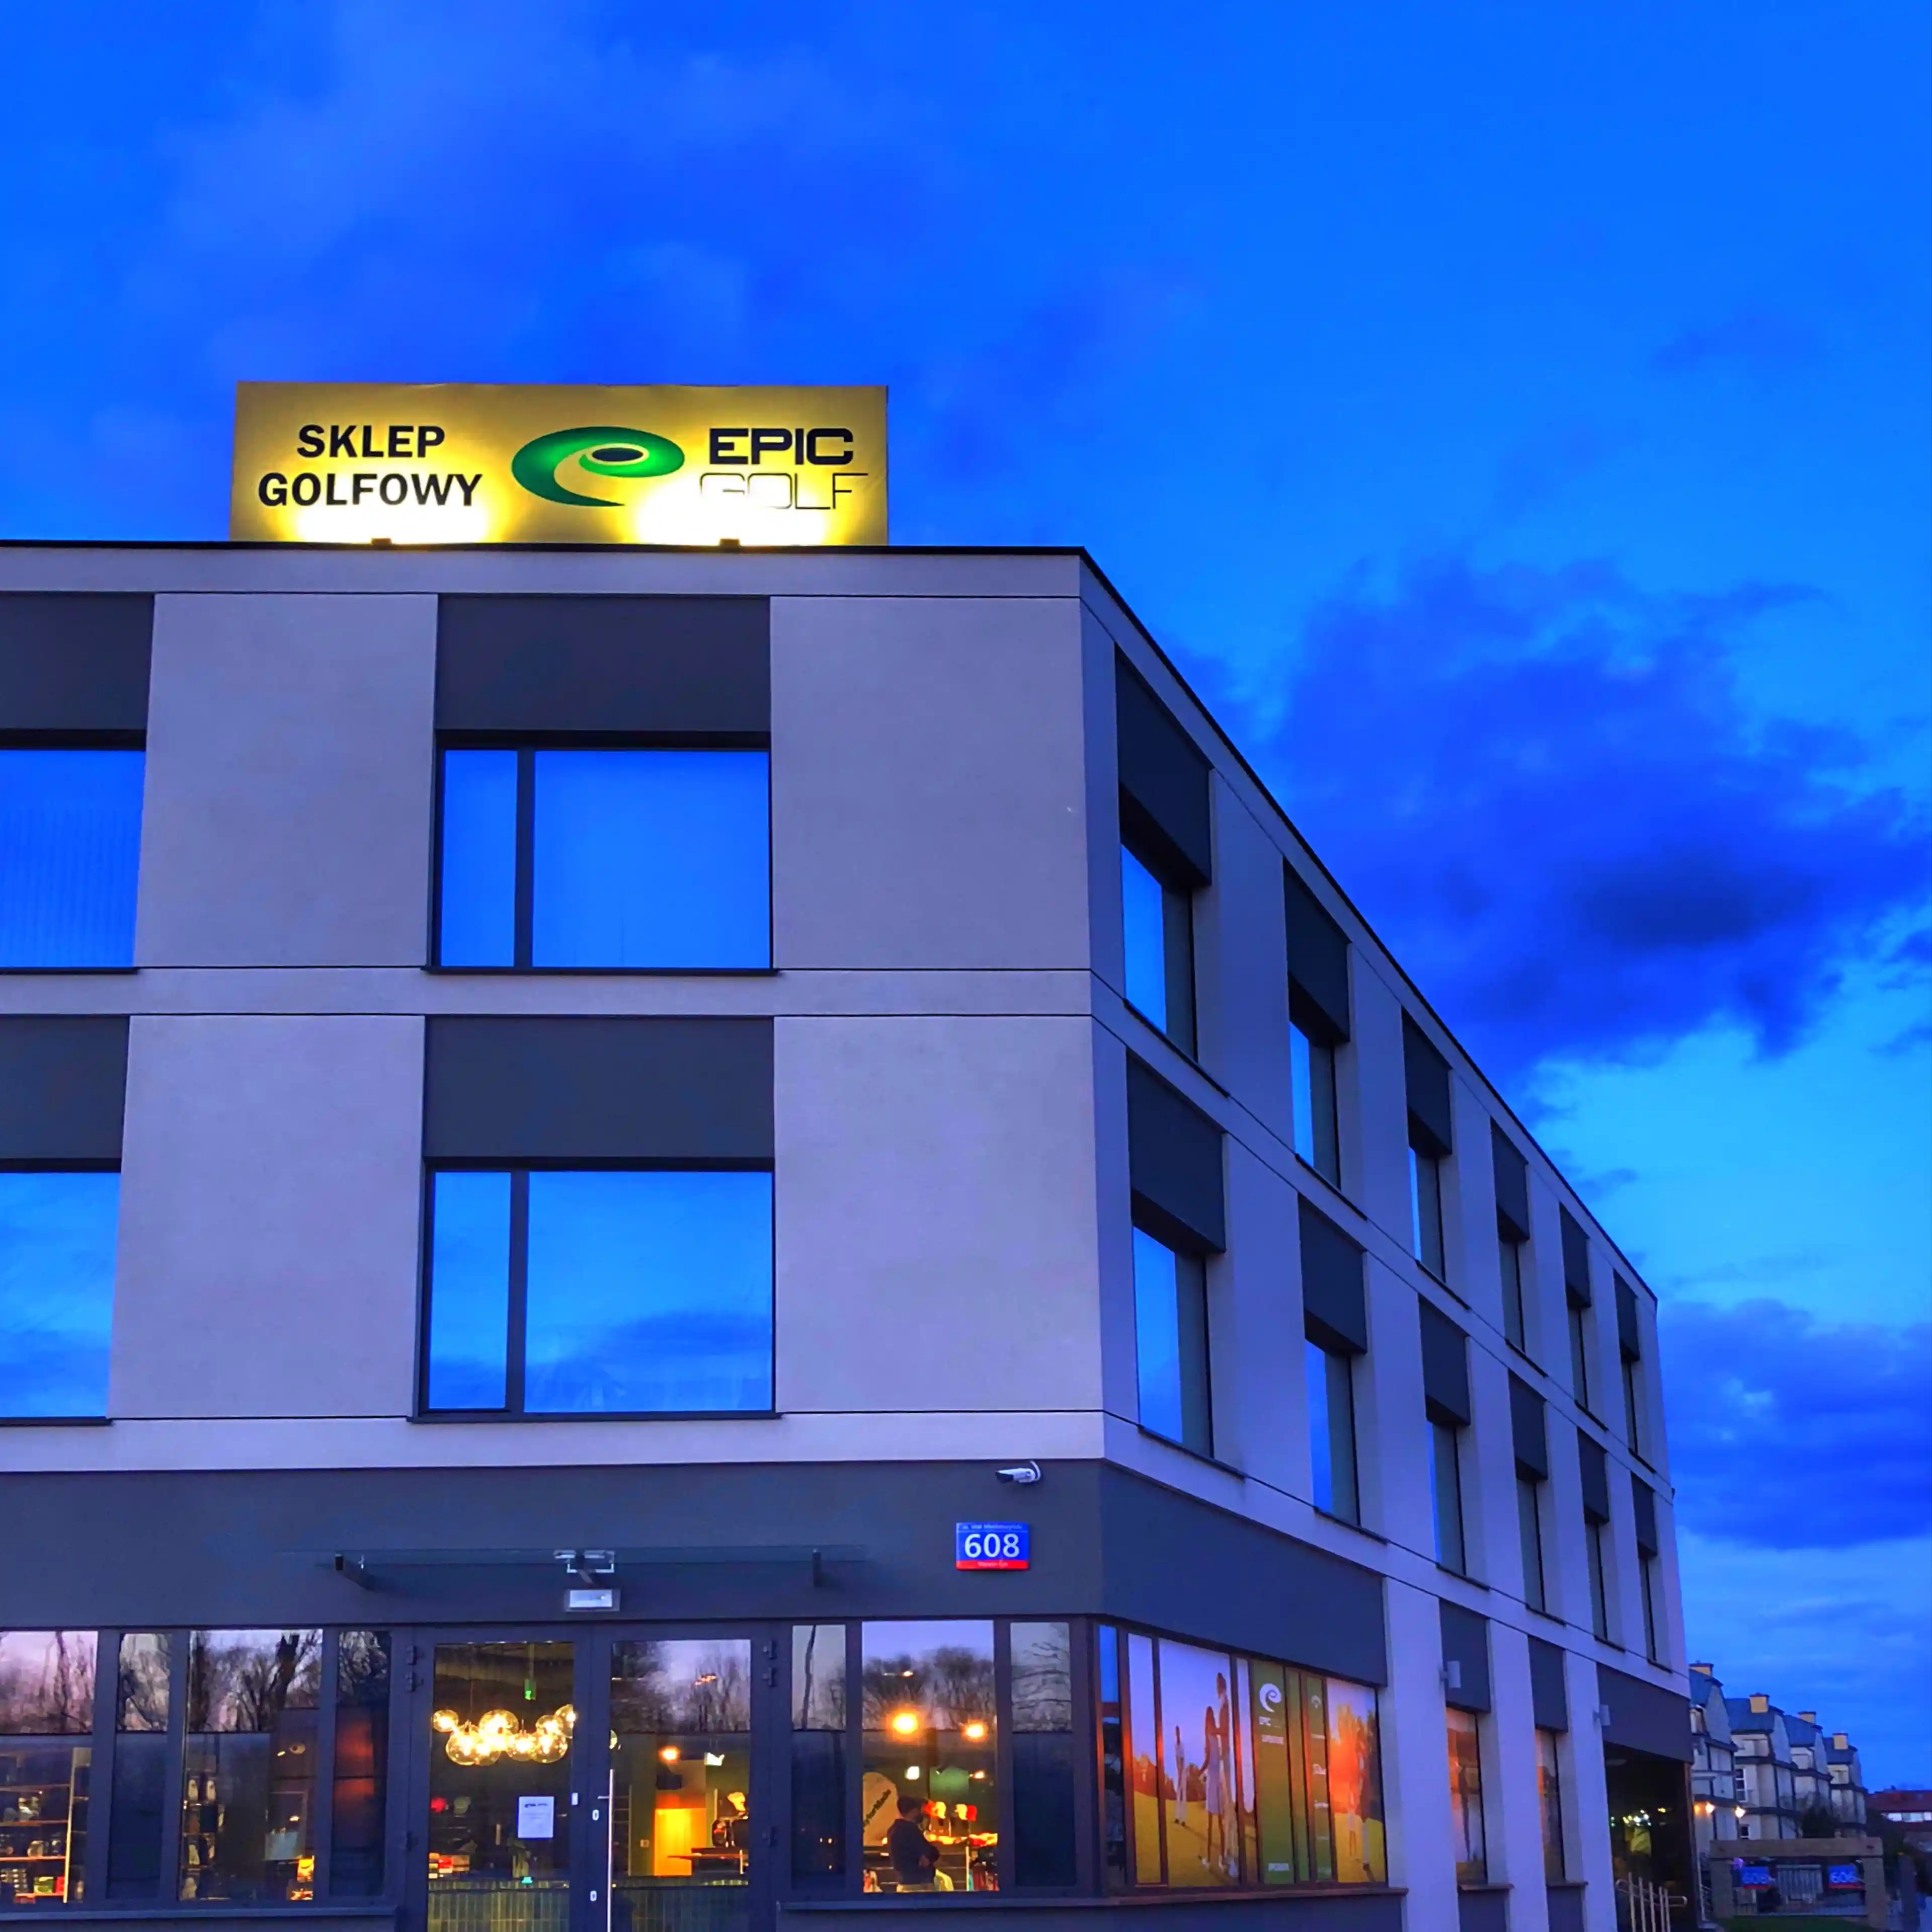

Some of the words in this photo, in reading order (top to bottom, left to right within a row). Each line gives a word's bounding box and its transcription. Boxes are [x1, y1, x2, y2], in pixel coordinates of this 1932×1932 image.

[297, 425, 445, 458] SKLEP
[709, 428, 854, 465] EPIC
[258, 472, 483, 507] GOLFOWY
[699, 472, 869, 510] GOLF
[964, 1533, 1020, 1558] 608
